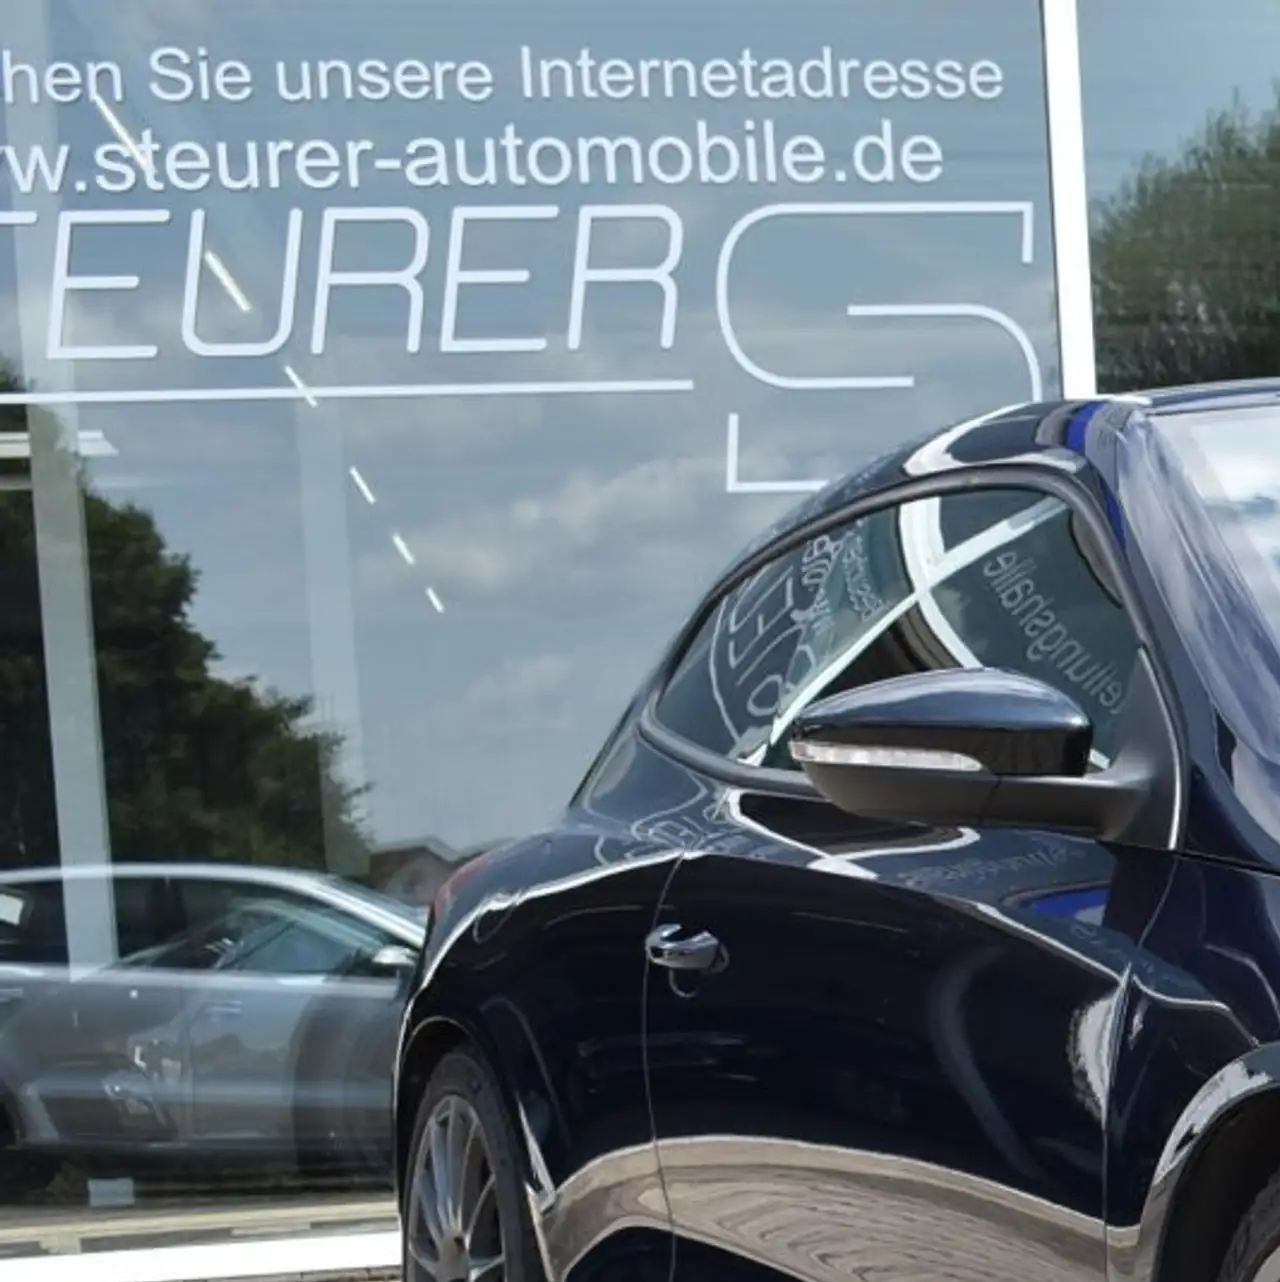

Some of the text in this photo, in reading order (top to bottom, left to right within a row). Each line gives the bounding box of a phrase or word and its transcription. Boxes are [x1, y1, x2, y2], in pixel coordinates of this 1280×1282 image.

[149, 46, 253, 102] Sie
[275, 55, 494, 101] unsere
[520, 45, 1004, 101] Internetadresse
